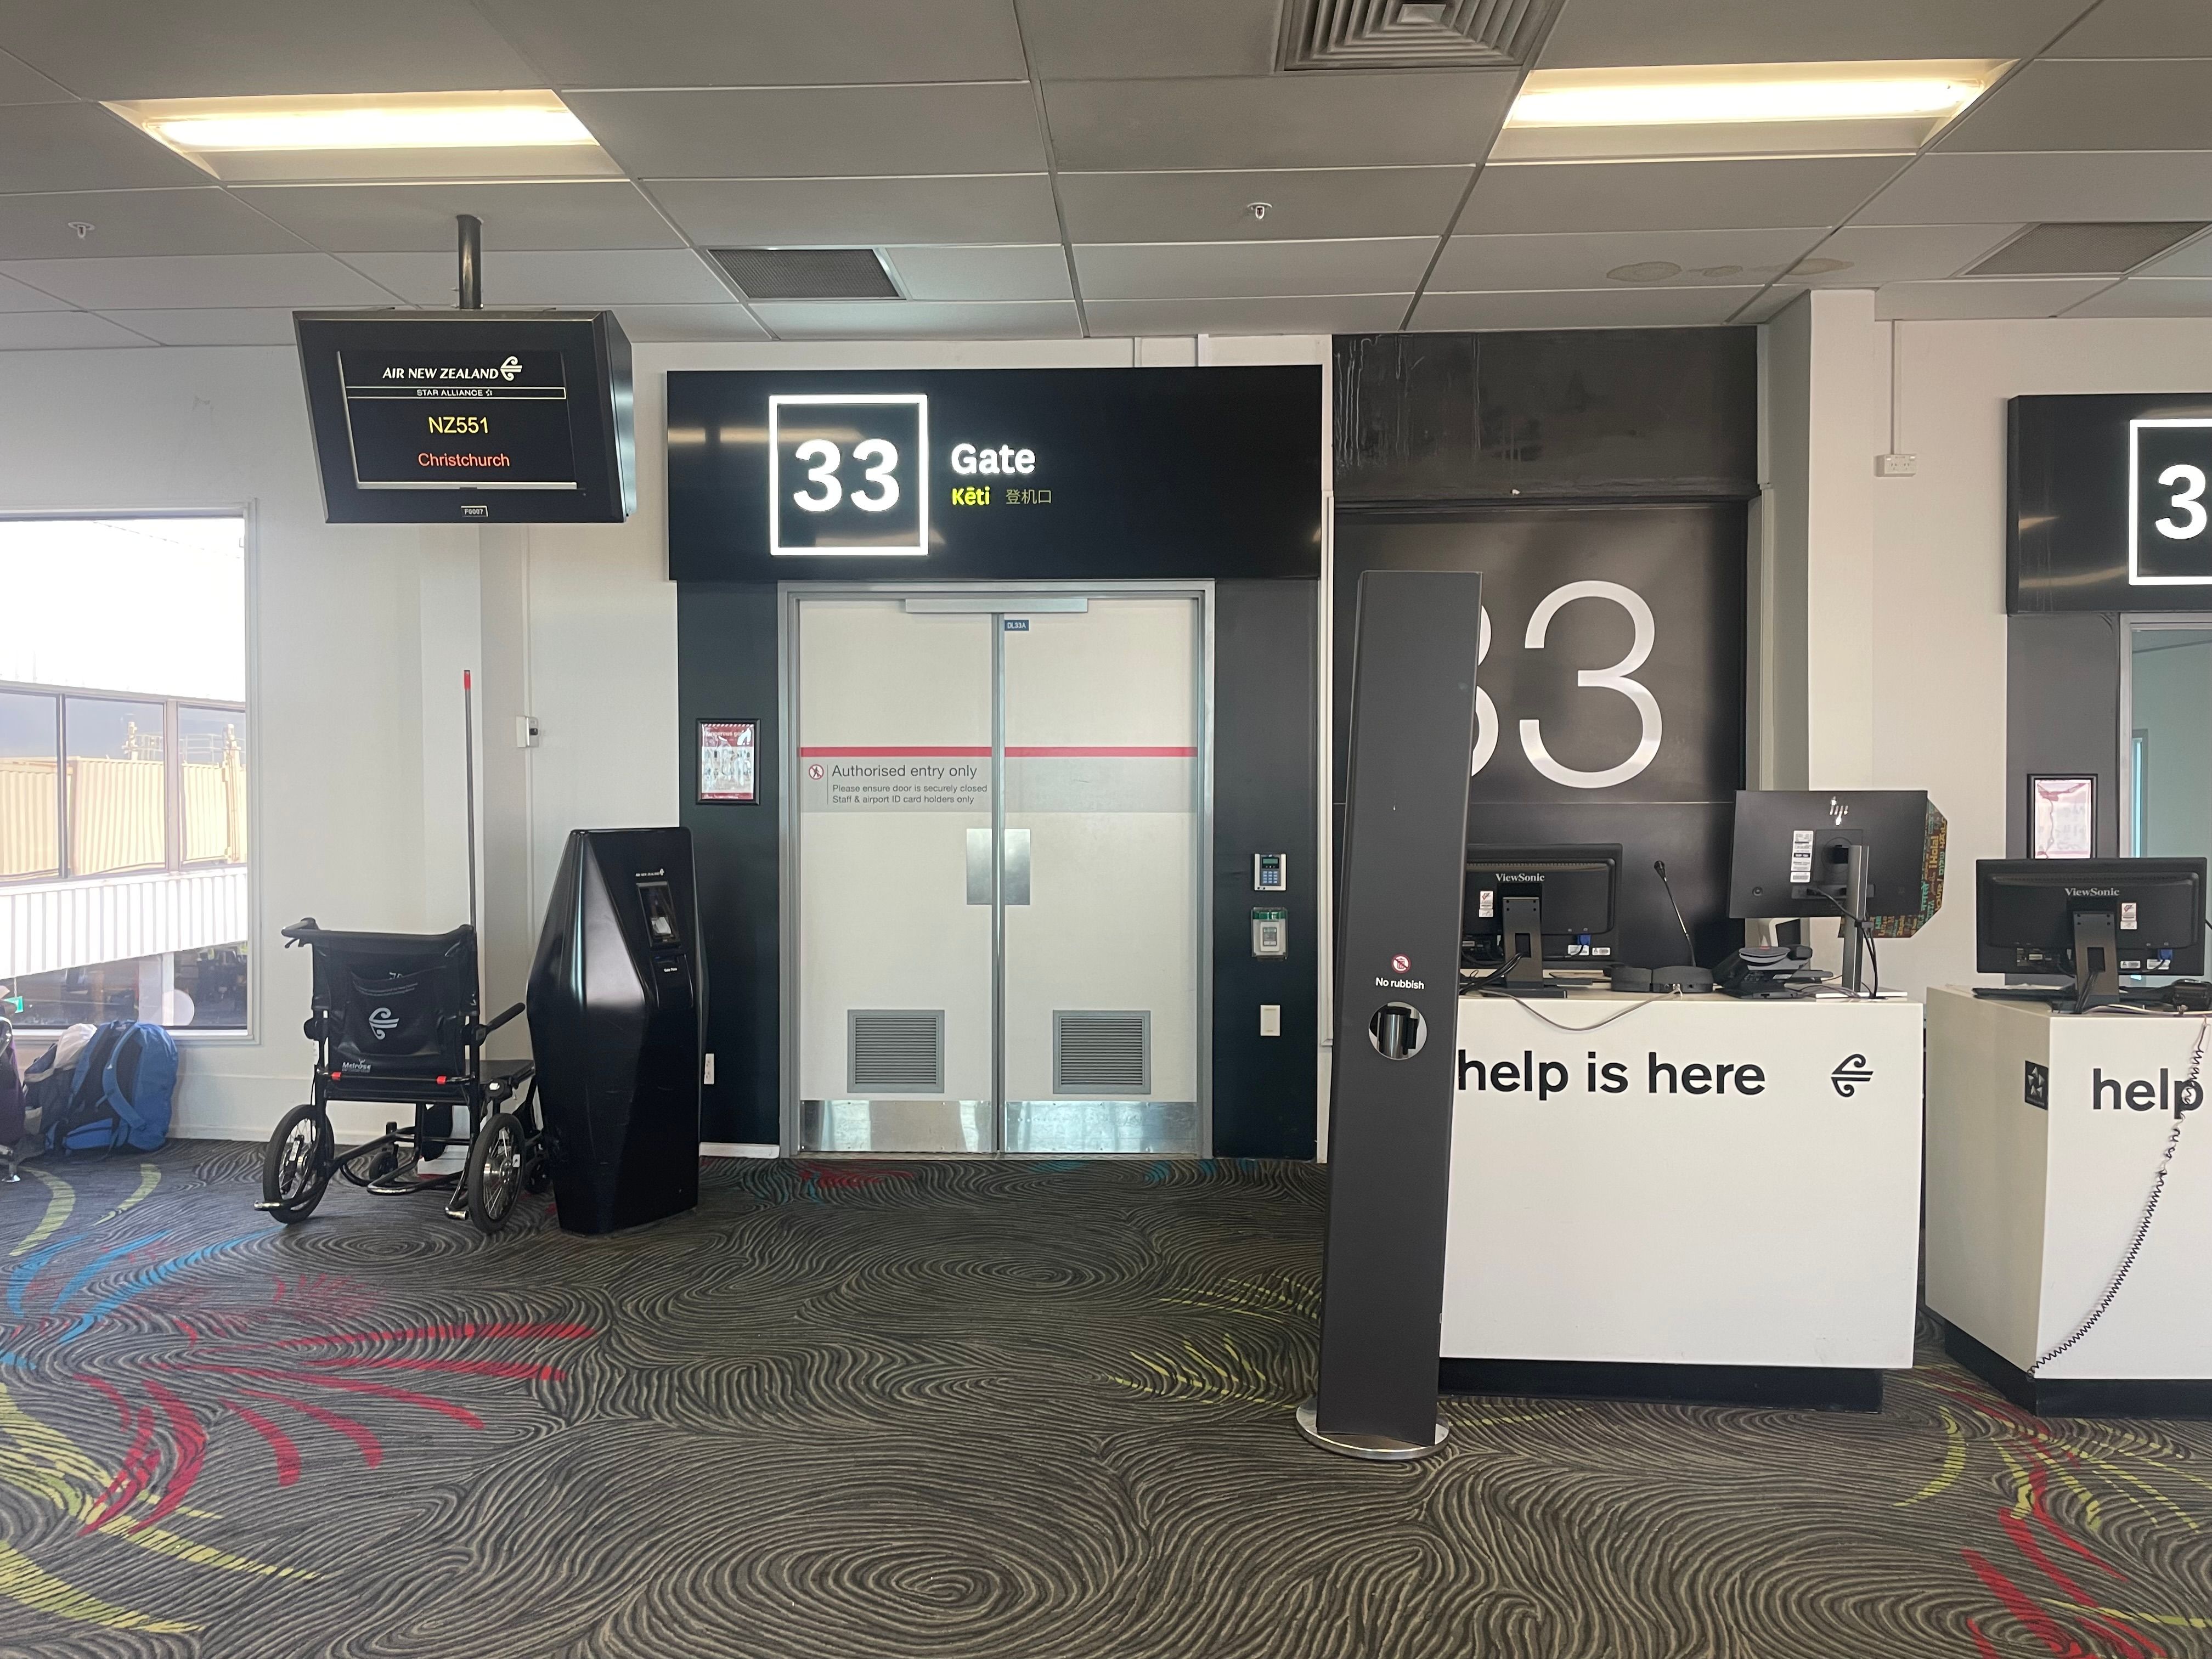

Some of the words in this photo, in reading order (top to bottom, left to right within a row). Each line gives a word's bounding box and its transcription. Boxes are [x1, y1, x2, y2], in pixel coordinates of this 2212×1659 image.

[382, 367, 404, 379] AIR
[408, 368, 437, 379] NEW
[439, 368, 499, 379] ZEALAND
[428, 416, 488, 433] NZ551
[418, 453, 510, 467] Christchurch
[951, 443, 1035, 475] Gate
[793, 439, 900, 512] 33
[952, 486, 990, 505] Kēti
[1006, 488, 1052, 504] 登机口
[1472, 580, 1663, 789] 3
[832, 765, 905, 777] Authorised
[910, 766, 945, 780] entry
[949, 765, 978, 780] only
[923, 785, 958, 794] securely
[862, 795, 889, 805] airport
[957, 795, 974, 805] only
[1496, 873, 1545, 882] ViewSonic
[2064, 888, 2120, 896] ViewSonic
[1375, 977, 1389, 986] No
[1390, 979, 1424, 990] rubbish
[1457, 1048, 1568, 1101] help
[1588, 1051, 1628, 1093] is
[1649, 1052, 1766, 1095] here
[2093, 1068, 2204, 1120] help
